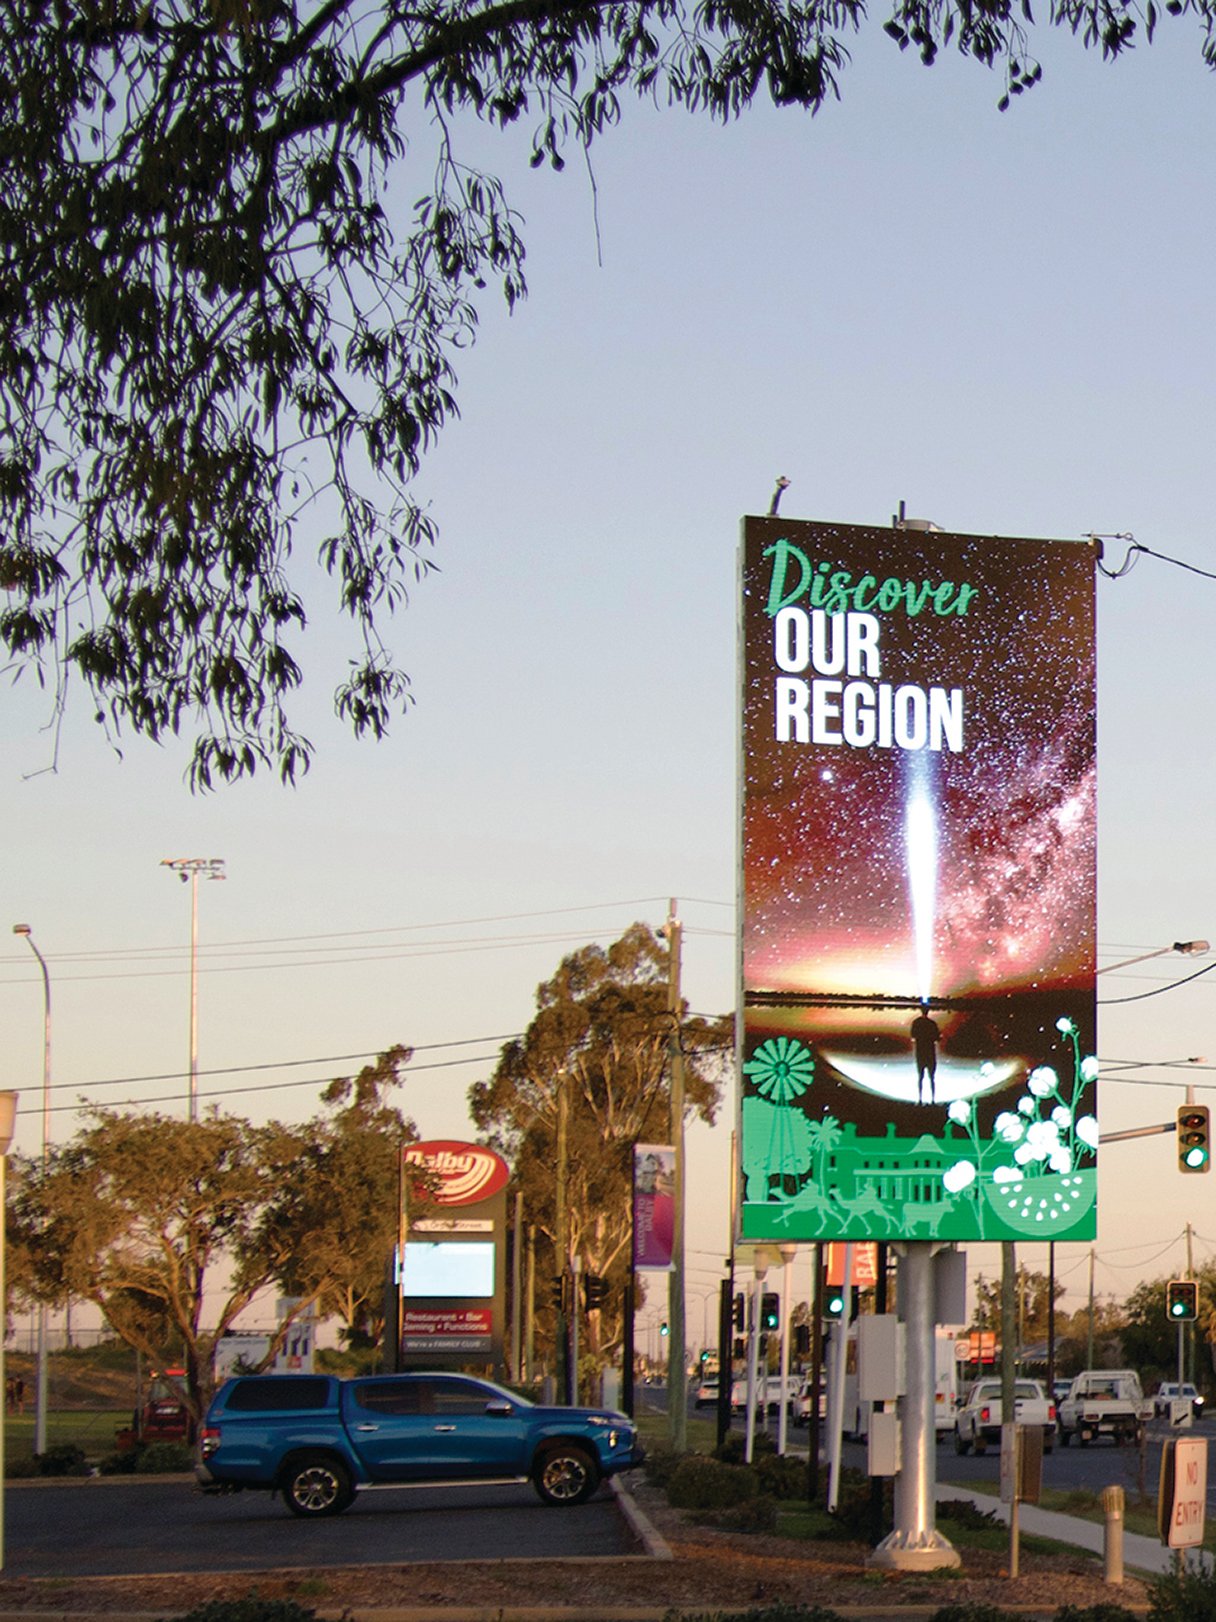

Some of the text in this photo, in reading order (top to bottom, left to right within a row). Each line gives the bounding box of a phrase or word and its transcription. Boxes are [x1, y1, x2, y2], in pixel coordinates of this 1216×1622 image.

[763, 539, 978, 617] Discover
[774, 606, 881, 678] OUR
[775, 677, 964, 752] REGION
[637, 1198, 645, 1257] WELCOME TO
[645, 1200, 653, 1232] DALBY
[405, 1312, 483, 1321] Restaurant Bar
[443, 1321, 488, 1331] Functions
[1187, 1461, 1198, 1486] NO
[1176, 1501, 1203, 1526] ENTRY
